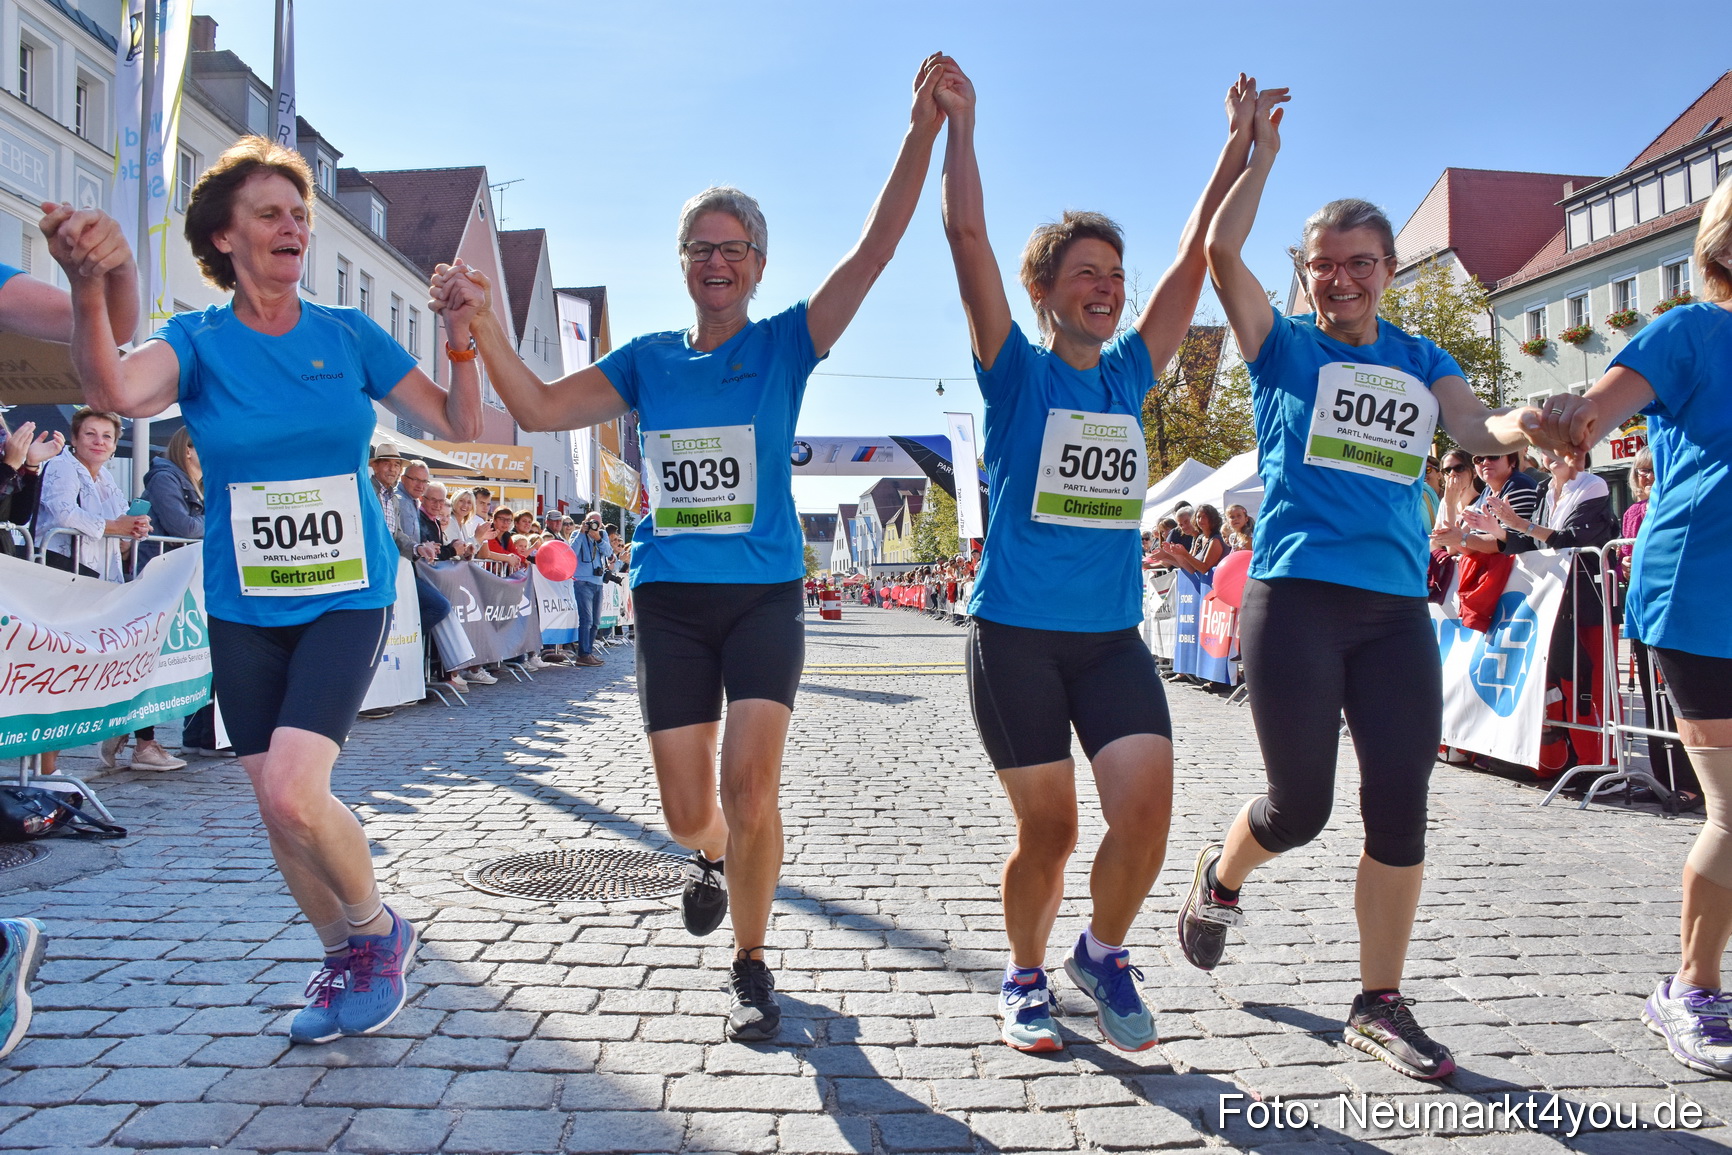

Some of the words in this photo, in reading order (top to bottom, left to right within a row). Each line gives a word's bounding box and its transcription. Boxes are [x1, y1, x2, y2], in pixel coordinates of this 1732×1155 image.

[301, 372, 344, 381] Gertraud
[1354, 372, 1406, 392] BOCK
[1332, 388, 1419, 437] 5042
[1083, 423, 1128, 438] BOCK
[1337, 427, 1362, 439] PARTL
[1362, 433, 1397, 446] Neumarkt
[672, 437, 722, 451] BOCK
[1059, 443, 1138, 482] 5036
[1342, 444, 1394, 467] Monika
[662, 457, 740, 492] 5039
[266, 489, 322, 506] BOCK
[1063, 483, 1088, 492] PARTL
[1089, 486, 1121, 495] Neumarkt
[692, 495, 725, 503] Neumarkt
[1063, 498, 1123, 516] Christine
[676, 510, 731, 527] Angelika
[252, 510, 344, 550] 5040
[290, 552, 328, 561] Neumarkt
[270, 566, 335, 584] Gertraud
